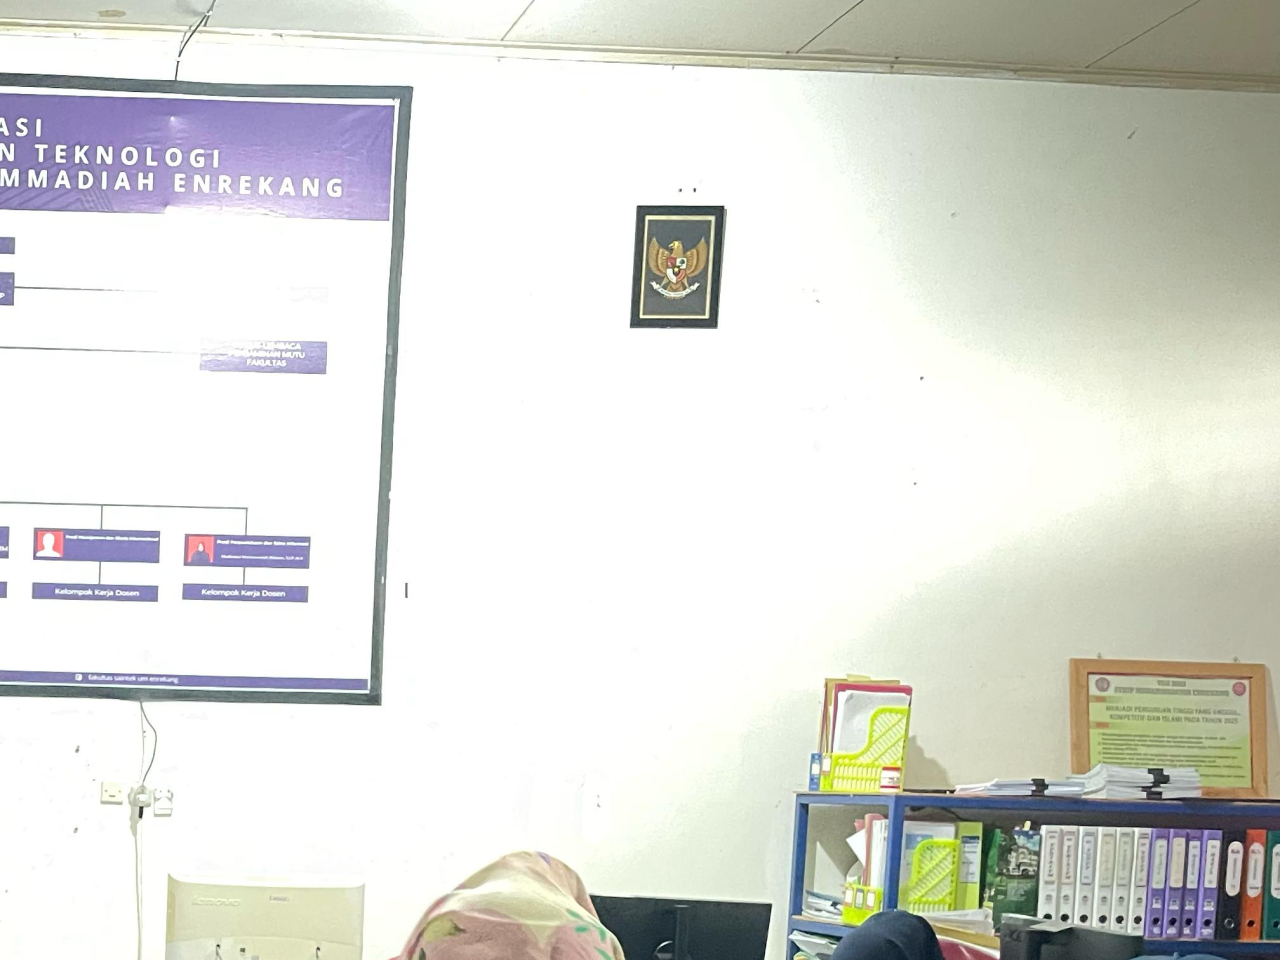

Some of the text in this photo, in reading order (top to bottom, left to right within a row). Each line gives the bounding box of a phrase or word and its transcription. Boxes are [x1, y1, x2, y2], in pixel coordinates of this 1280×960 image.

[34, 143, 220, 169] TEKNOLOGI
[173, 173, 344, 198] ENREKANG
[282, 351, 306, 359] MUTU
[246, 359, 287, 367] FAKULTAS
[55, 588, 140, 597] Kelompok Kerja Dosen
[201, 588, 239, 597] Kelompok
[241, 589, 260, 597] Kerja
